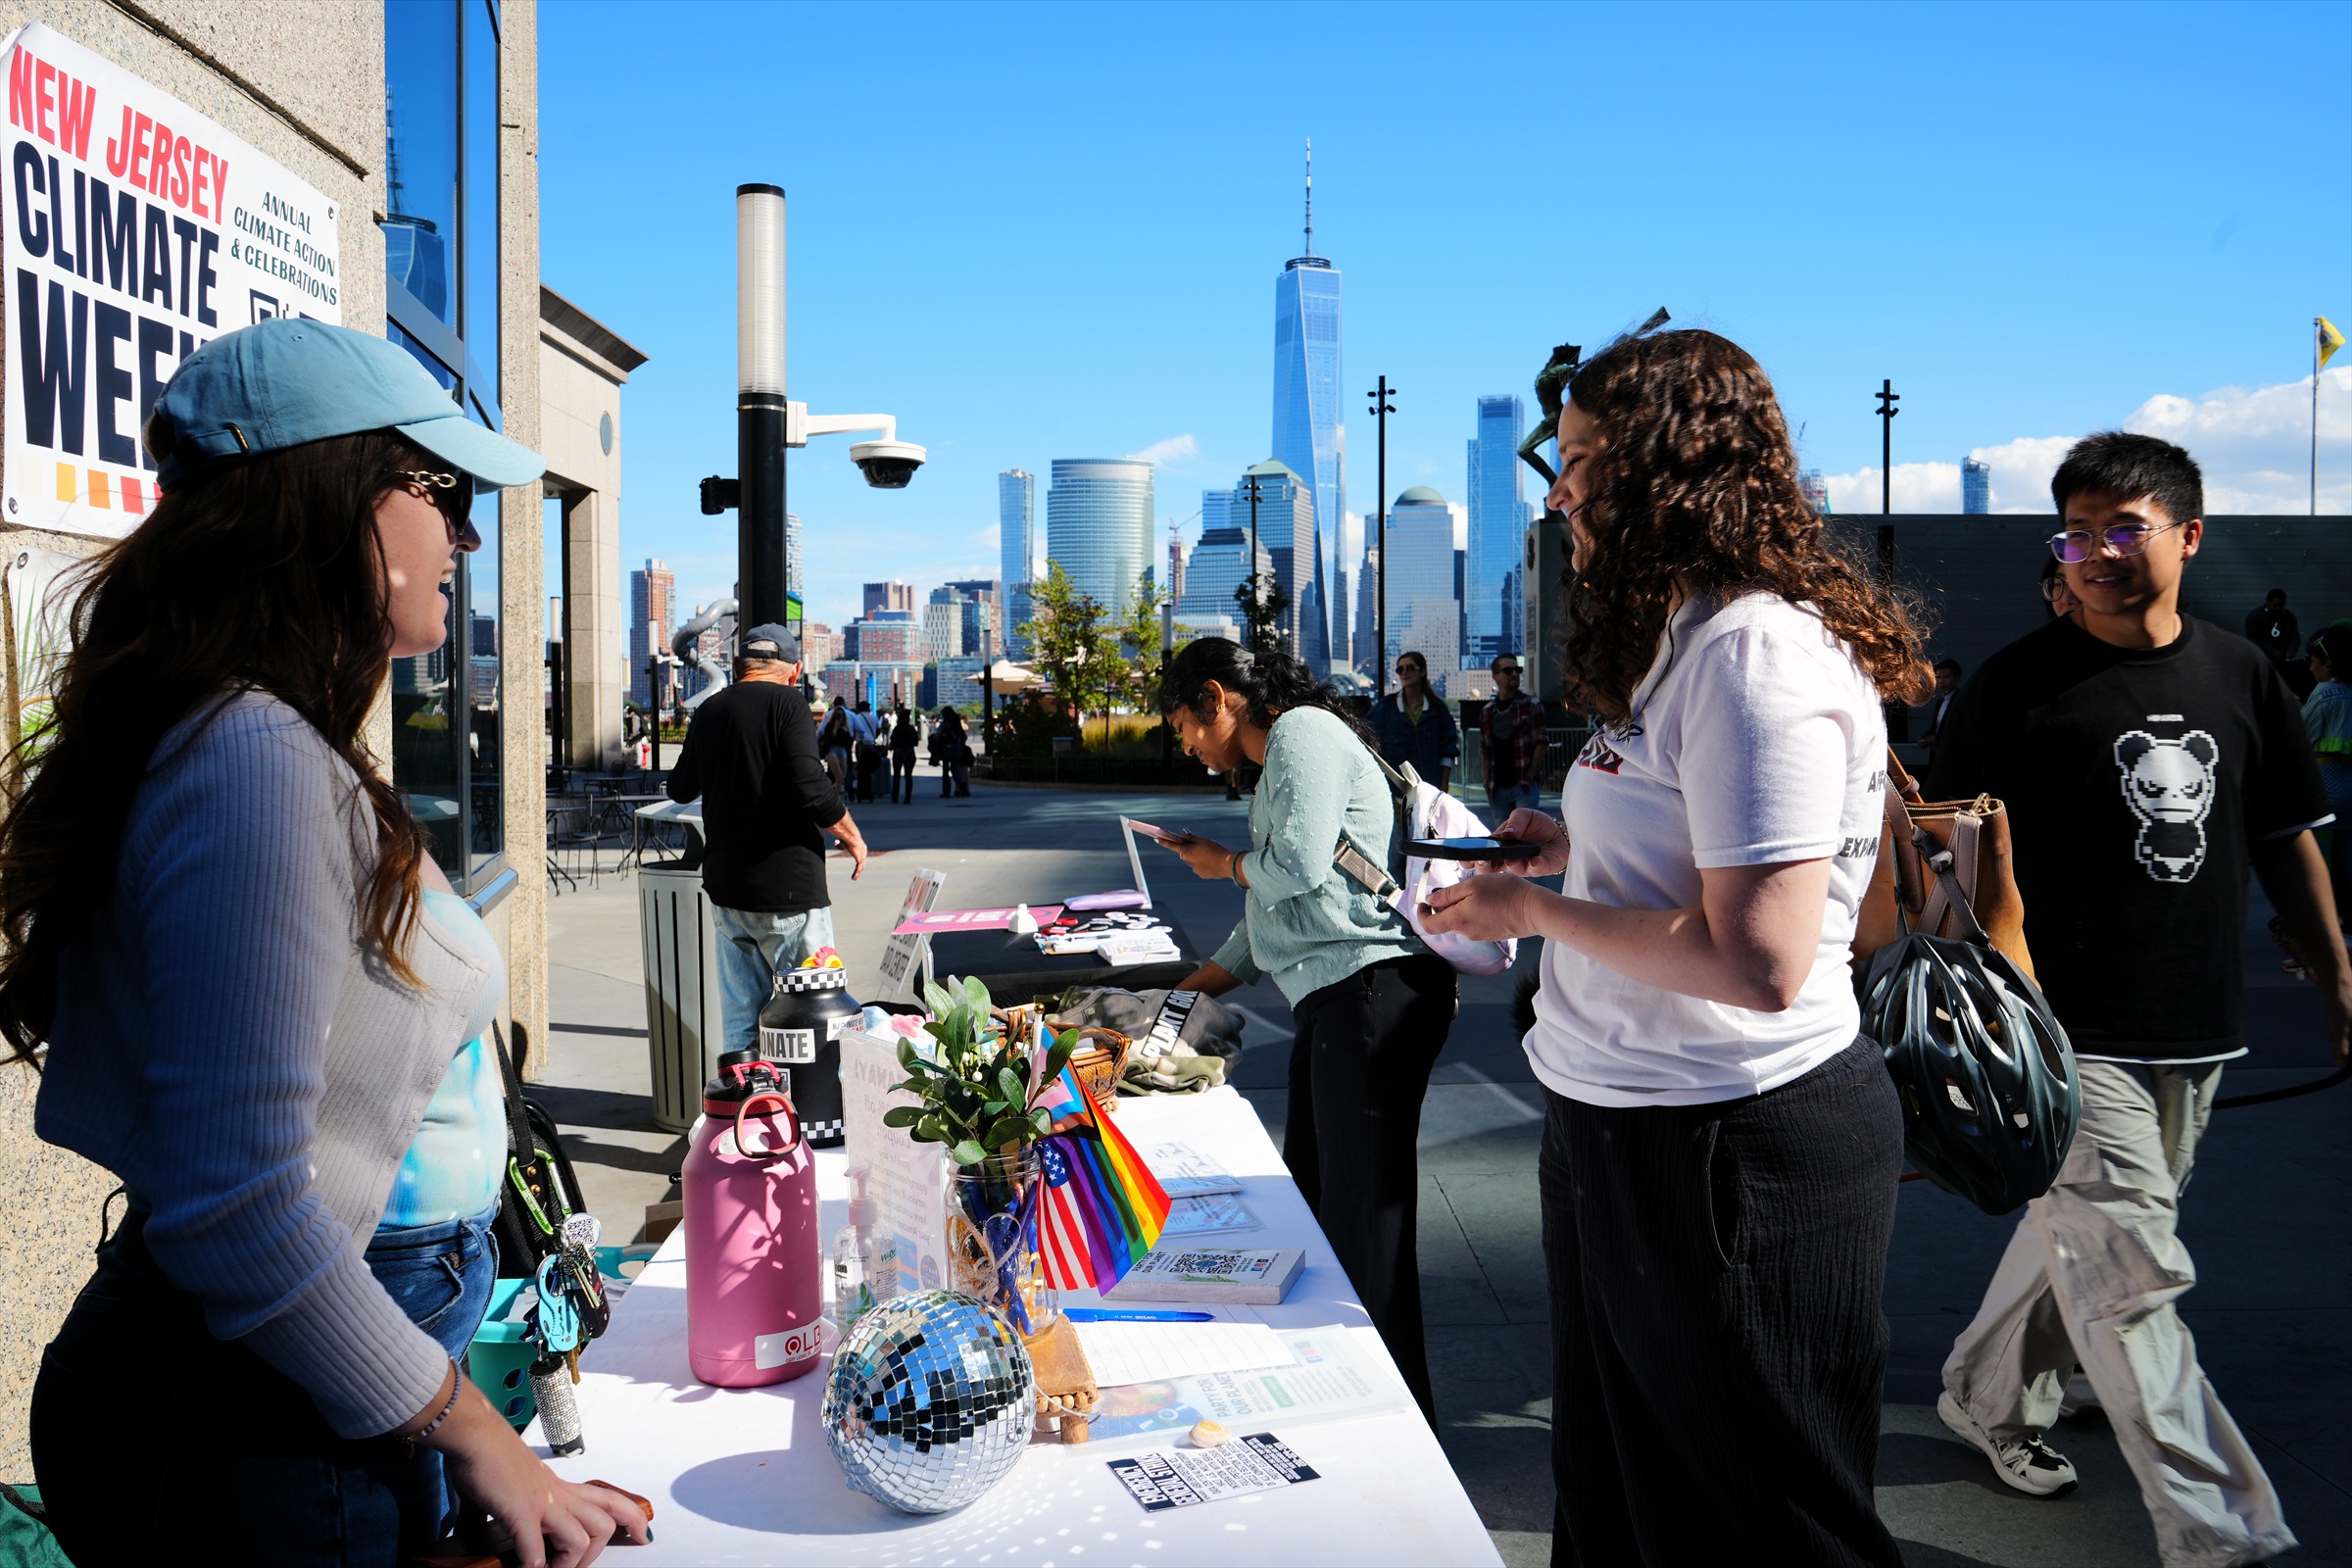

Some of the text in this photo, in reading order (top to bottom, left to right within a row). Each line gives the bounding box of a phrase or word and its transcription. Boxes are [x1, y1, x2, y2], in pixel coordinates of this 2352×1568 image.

[9, 44, 228, 225] NEW JERSEY
[13, 140, 219, 328] CLIMATE
[262, 191, 312, 235] ANNUAL
[233, 206, 336, 277] CLIMATE ACTION
[230, 238, 337, 306] & CELEBRATIONS
[17, 268, 207, 471] WEE
[1142, 1006, 1187, 1057] PLANT
[1197, 1377, 1232, 1418] PARTY FOR
[1213, 1372, 1252, 1415] OUR PLANET
[1113, 1463, 1169, 1504] EMERGENCY
[1134, 1453, 1202, 1506] GENERAL STRIKE
